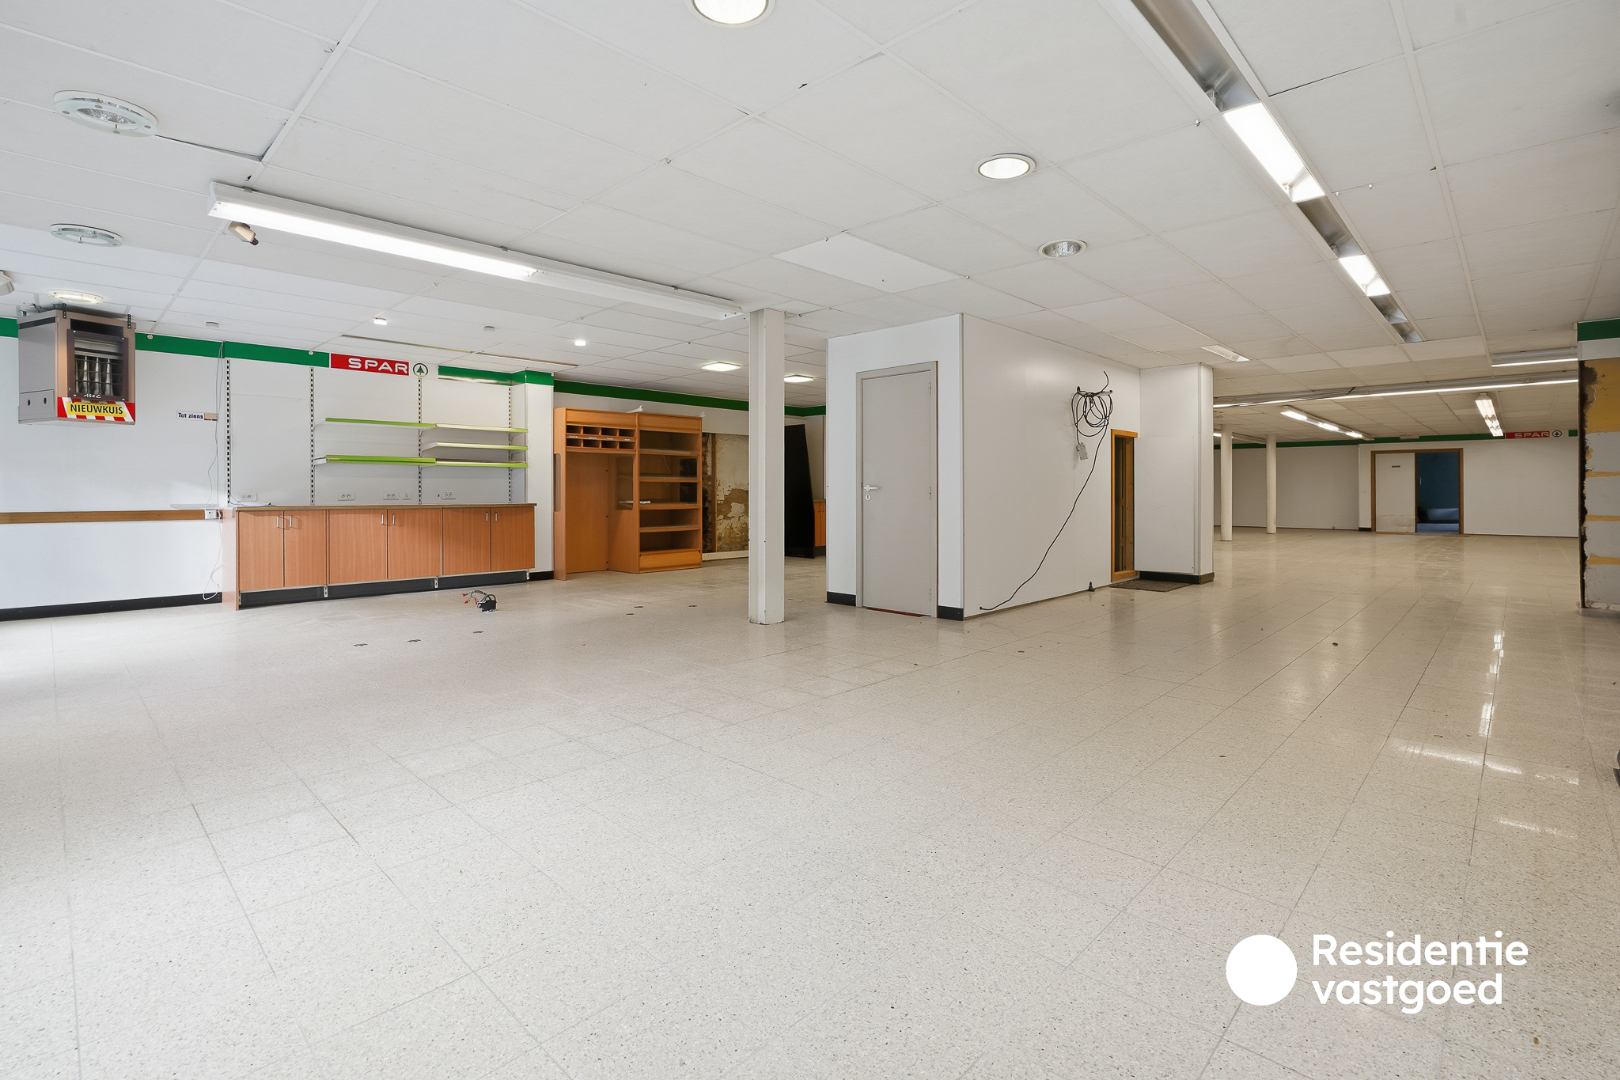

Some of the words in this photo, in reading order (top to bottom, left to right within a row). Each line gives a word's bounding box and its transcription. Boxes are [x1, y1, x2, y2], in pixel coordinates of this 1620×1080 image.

[348, 357, 408, 374] SPAR
[70, 403, 123, 415] NIEUWKUIS
[1514, 431, 1549, 439] SPAR
